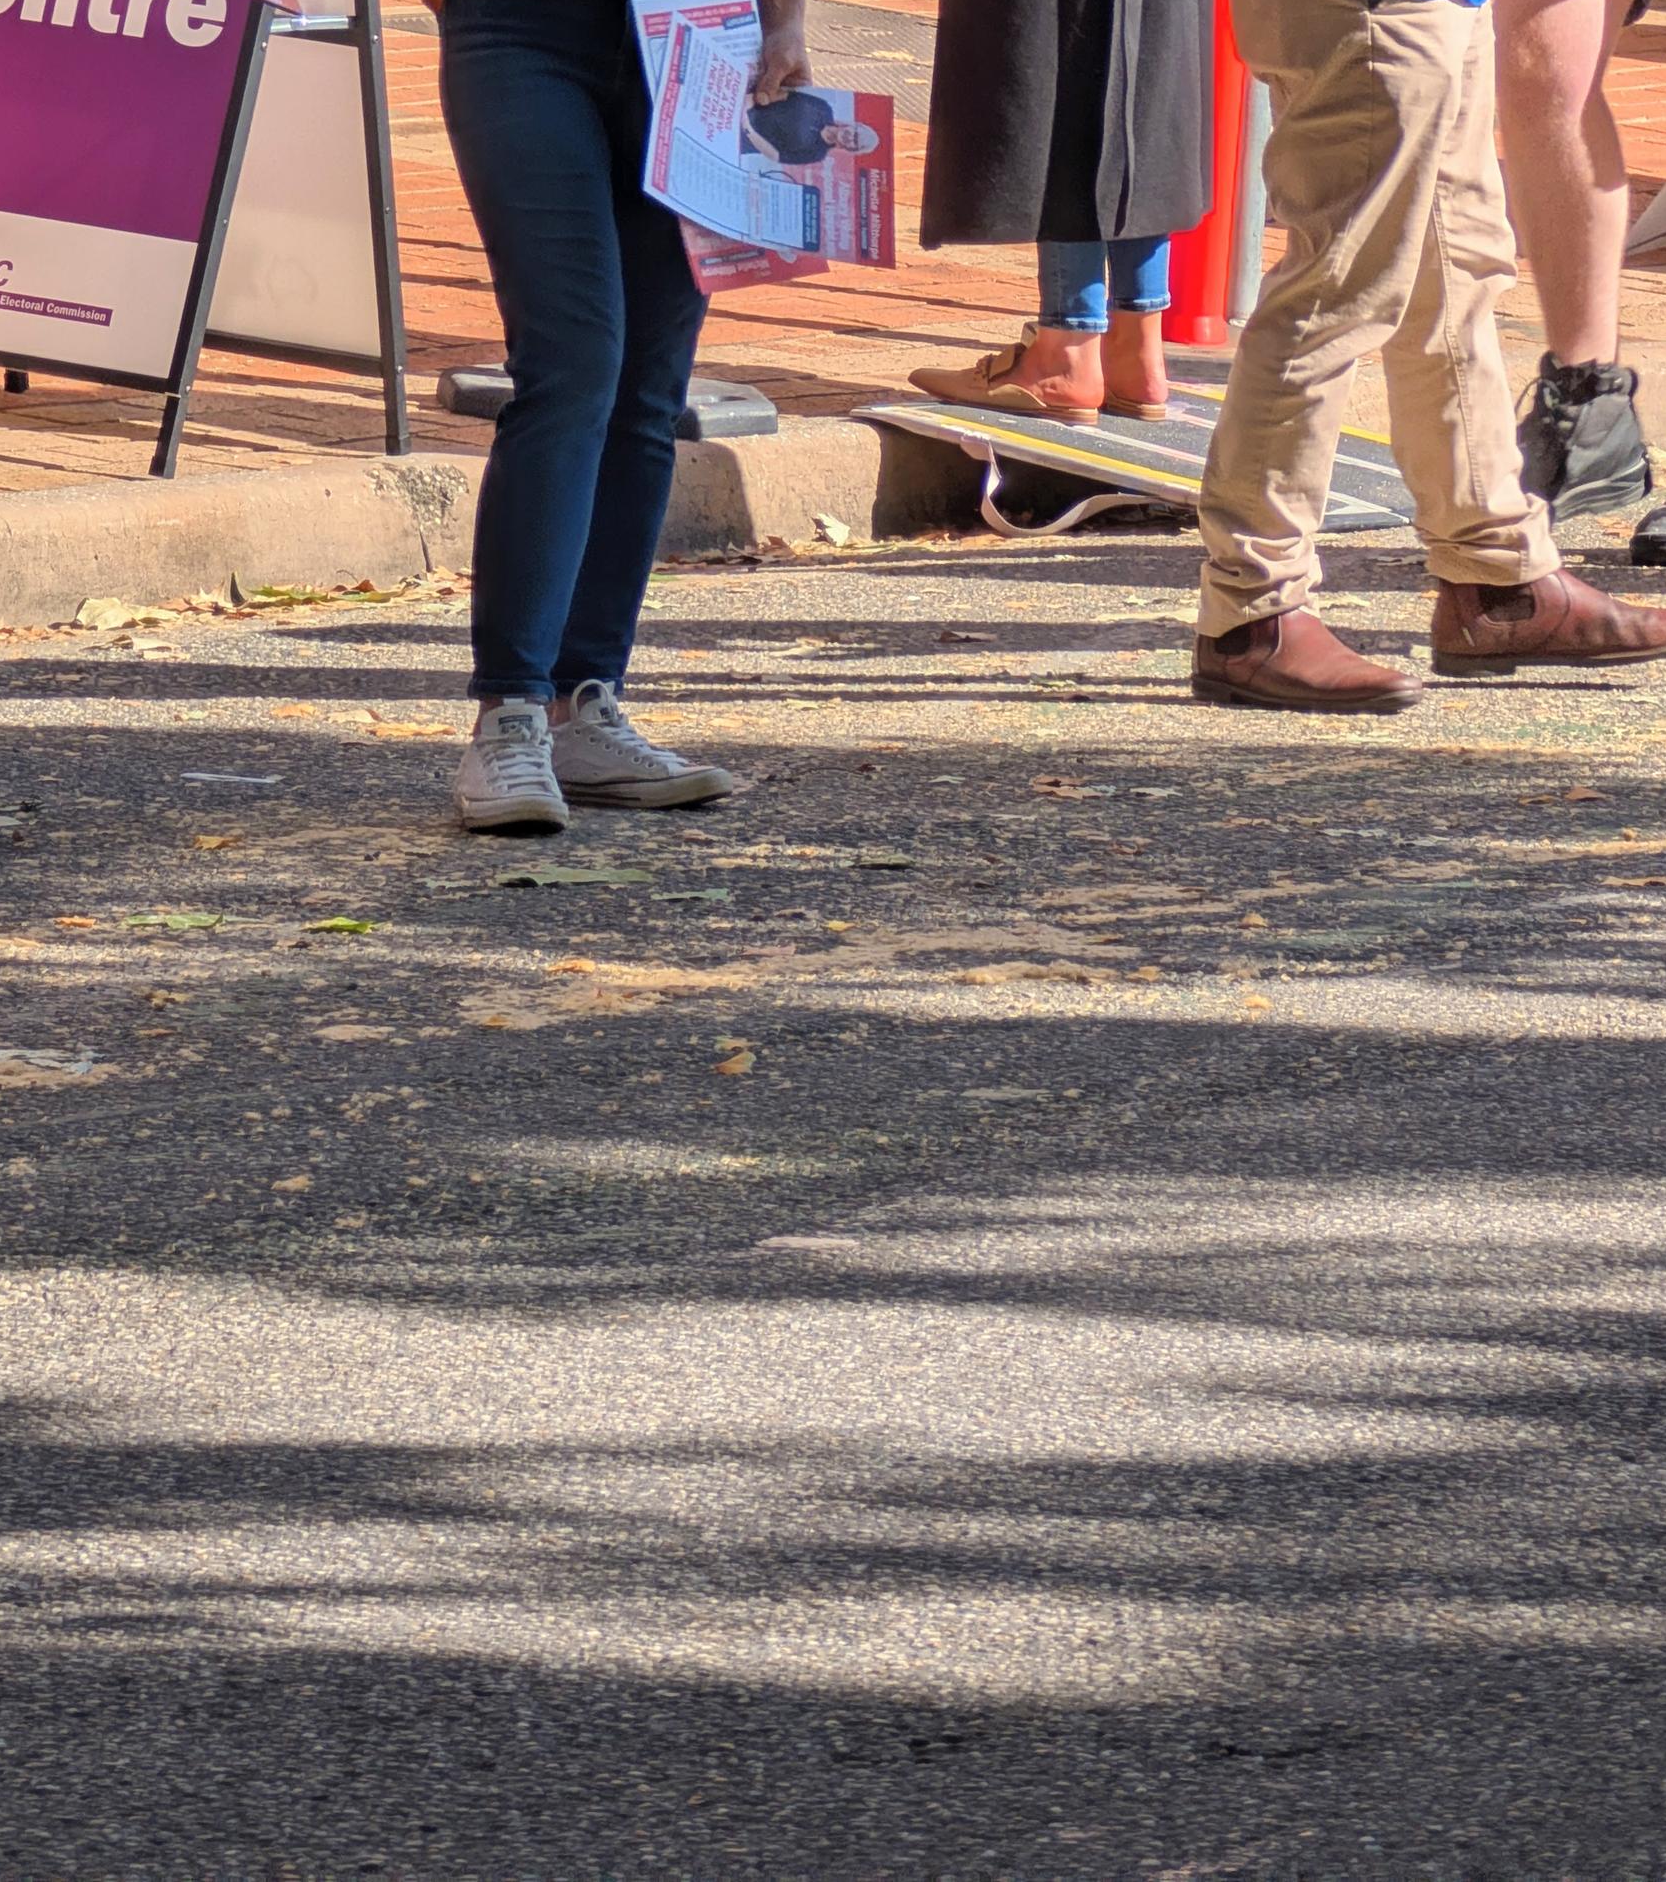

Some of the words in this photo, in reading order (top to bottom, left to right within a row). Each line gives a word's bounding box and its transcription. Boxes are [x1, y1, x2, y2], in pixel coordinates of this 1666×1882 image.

[869, 169, 880, 211] Michelle
[0, 294, 45, 312] Electoral
[46, 302, 107, 322] Commission
